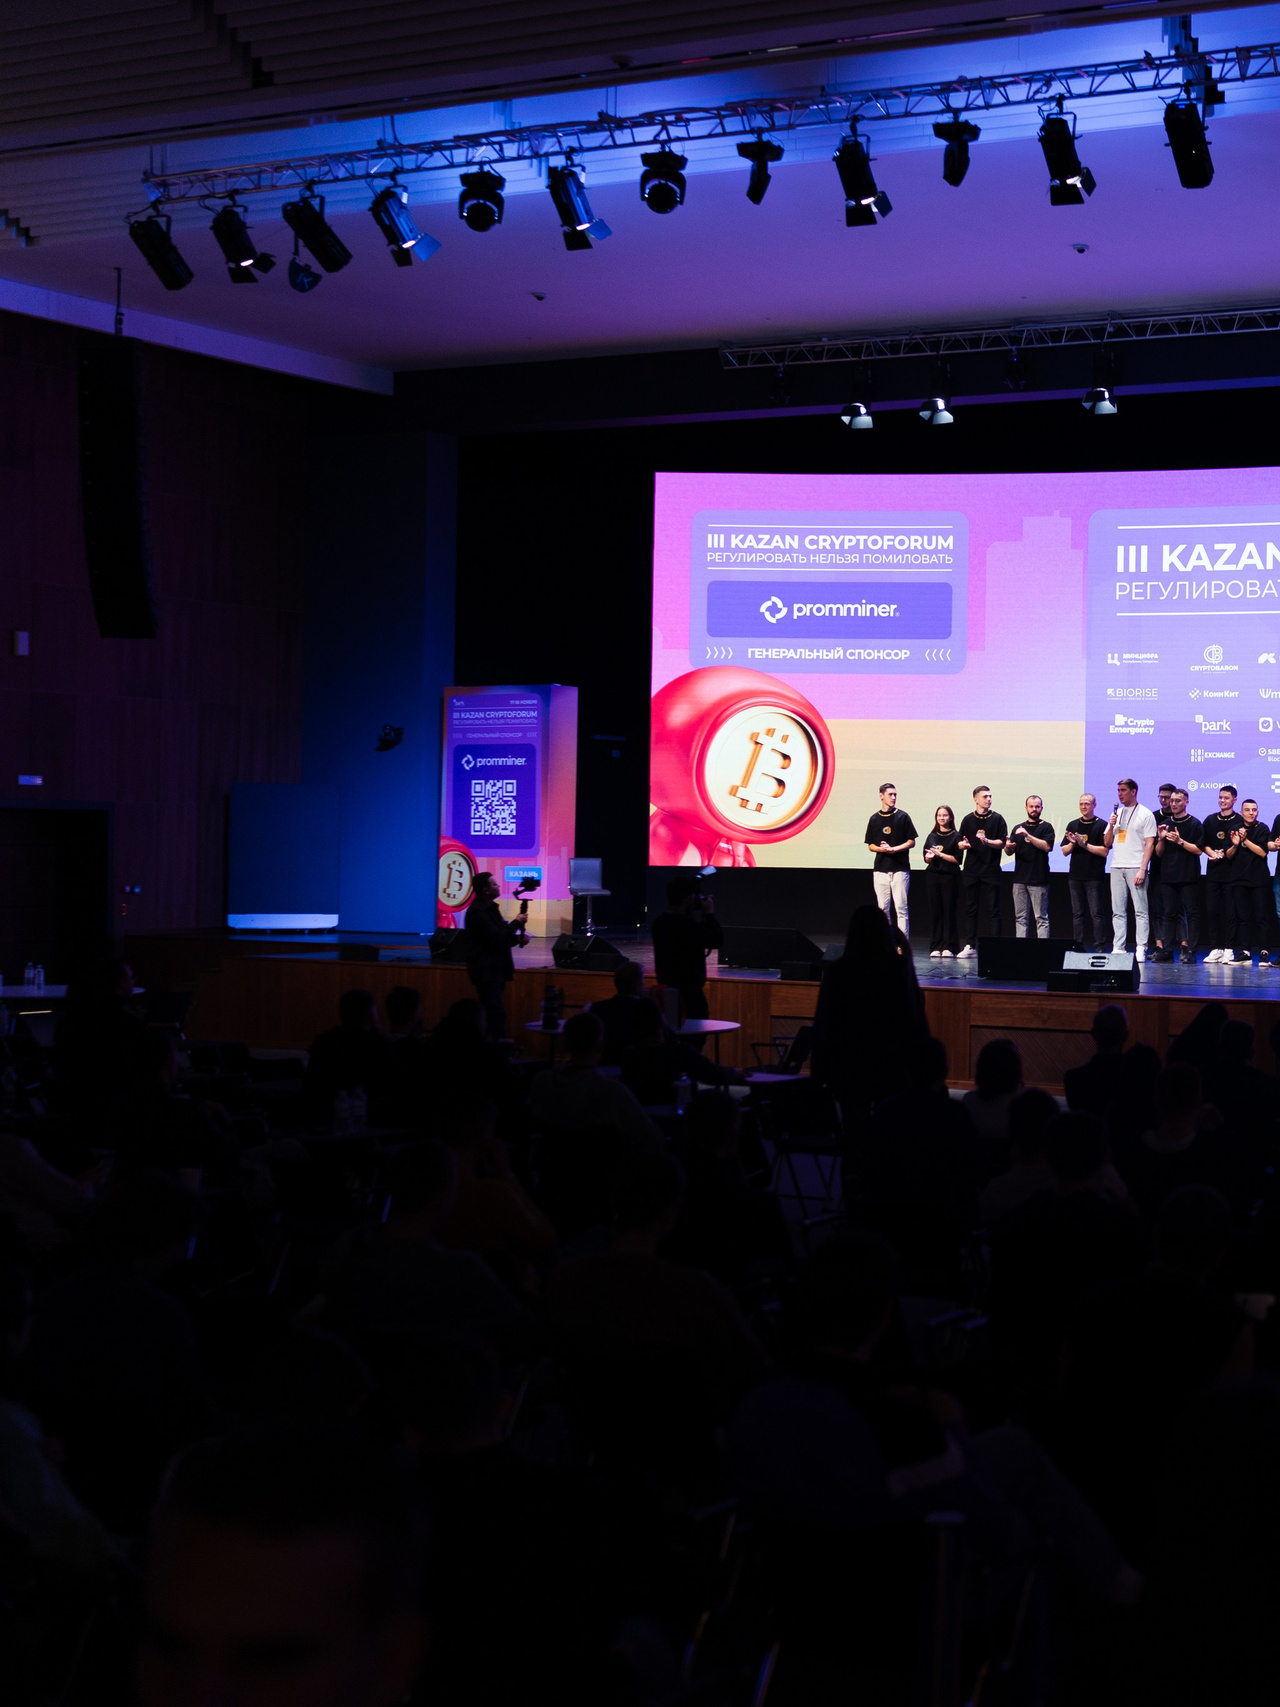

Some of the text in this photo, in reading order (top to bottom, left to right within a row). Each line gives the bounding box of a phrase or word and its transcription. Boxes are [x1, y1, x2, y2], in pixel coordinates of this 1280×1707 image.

[707, 534, 953, 550] III KAZAN CRYPTOFORUM
[707, 552, 953, 565] РЕГУЛИРОВАТЬ НЕЛЬЗЯ ПОМИЛОВАТЬ
[1116, 545, 1148, 572] III
[748, 647, 910, 661] ГЕНЕРАЛЬНЫЙ СПОНСОР
[1116, 688, 1158, 697] BIORISE
[1128, 718, 1155, 727] Crypto
[1202, 719, 1231, 734] park
[1110, 725, 1154, 735] Emergency
